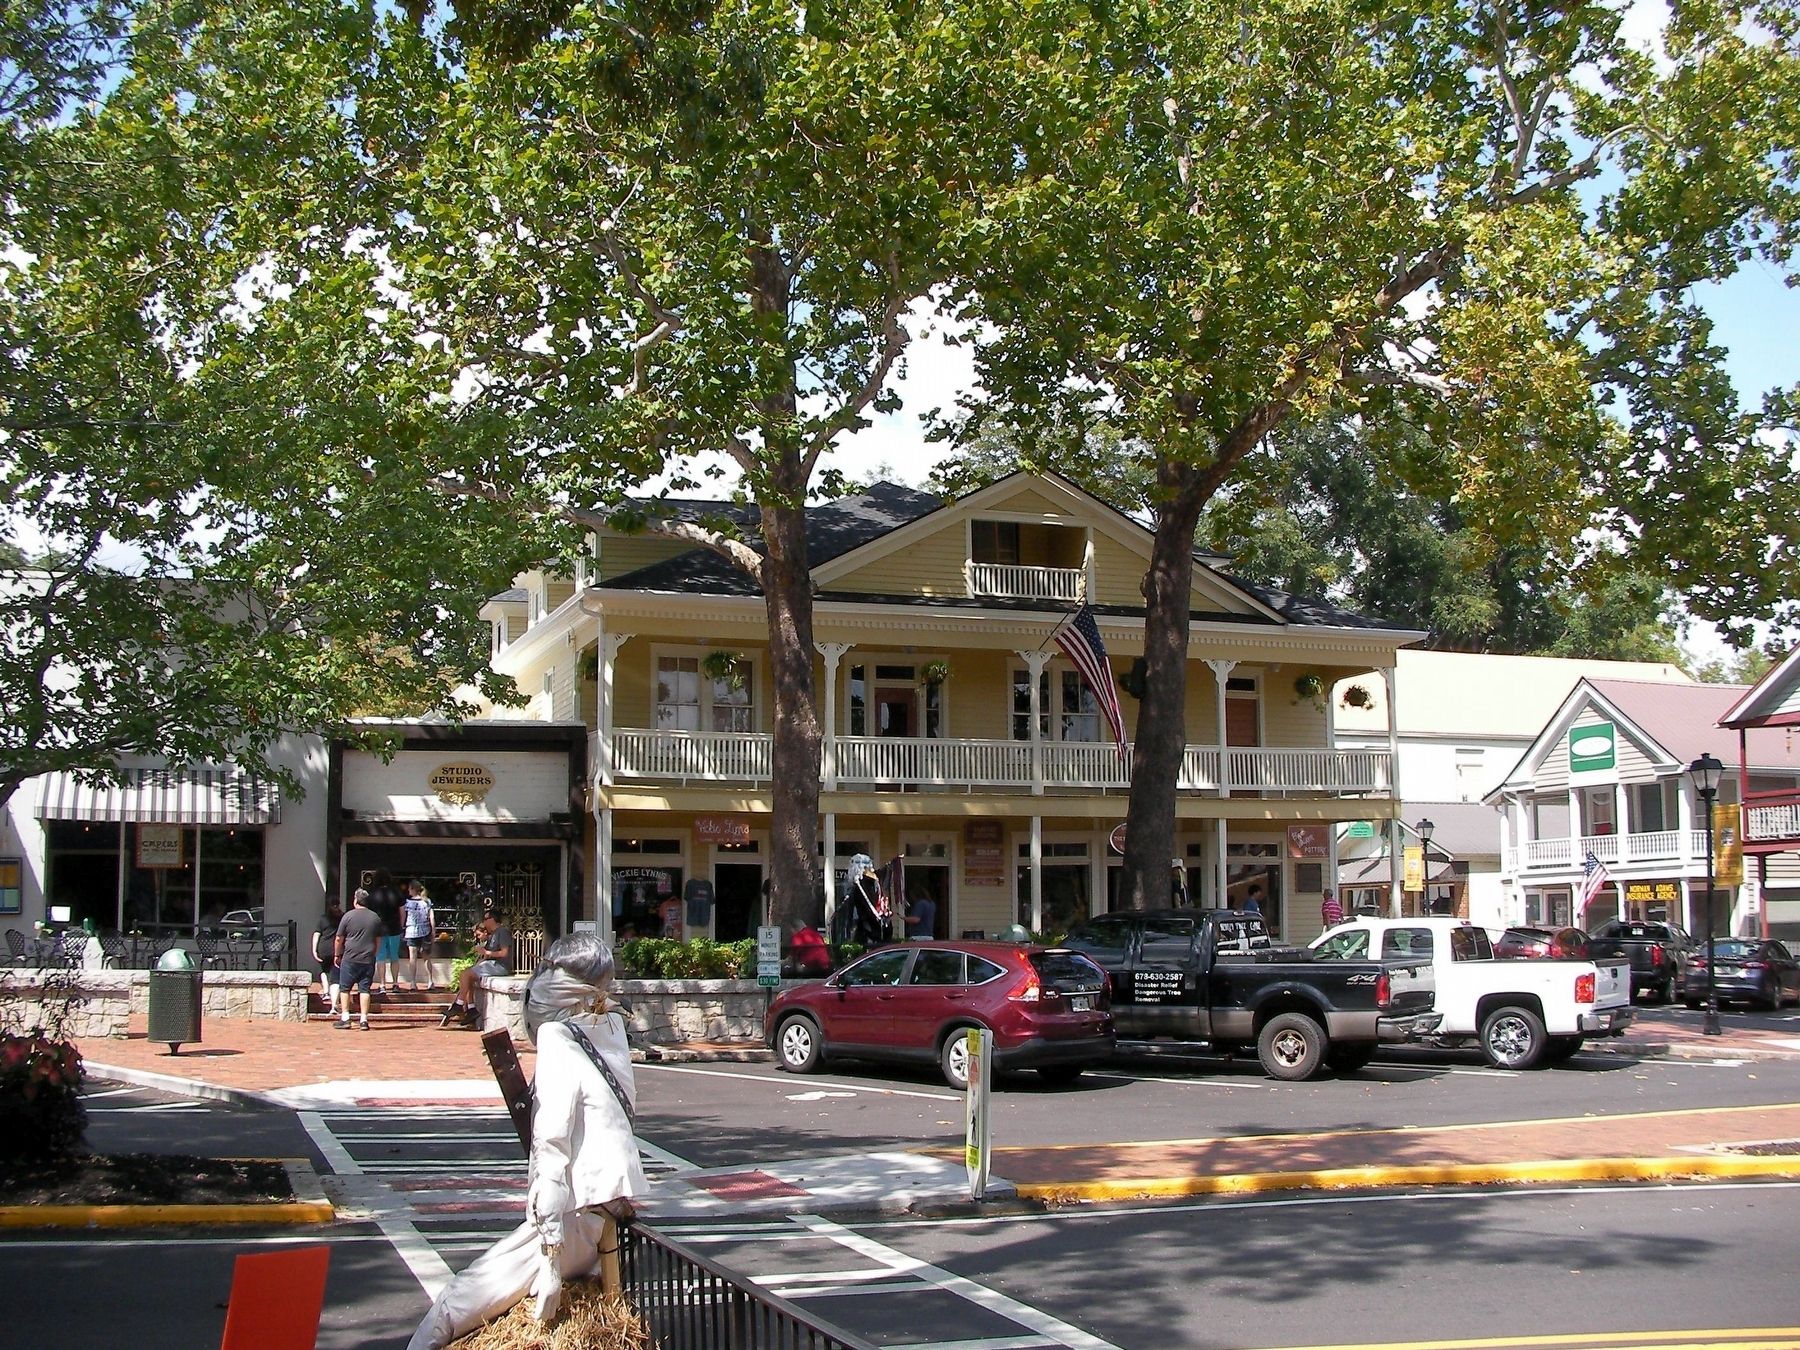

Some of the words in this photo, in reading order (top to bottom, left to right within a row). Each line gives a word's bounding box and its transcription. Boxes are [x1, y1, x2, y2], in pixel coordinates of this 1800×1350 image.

[441, 767, 482, 775] STUDIO
[432, 776, 492, 785] JEWELERS
[609, 868, 639, 880] VICKIE
[1656, 884, 1674, 892] ADAMS
[1626, 892, 1655, 900] INSURANCE
[1657, 891, 1678, 899] AGENCY
[765, 931, 773, 939] 15
[1135, 972, 1183, 980] 678-630-2587
